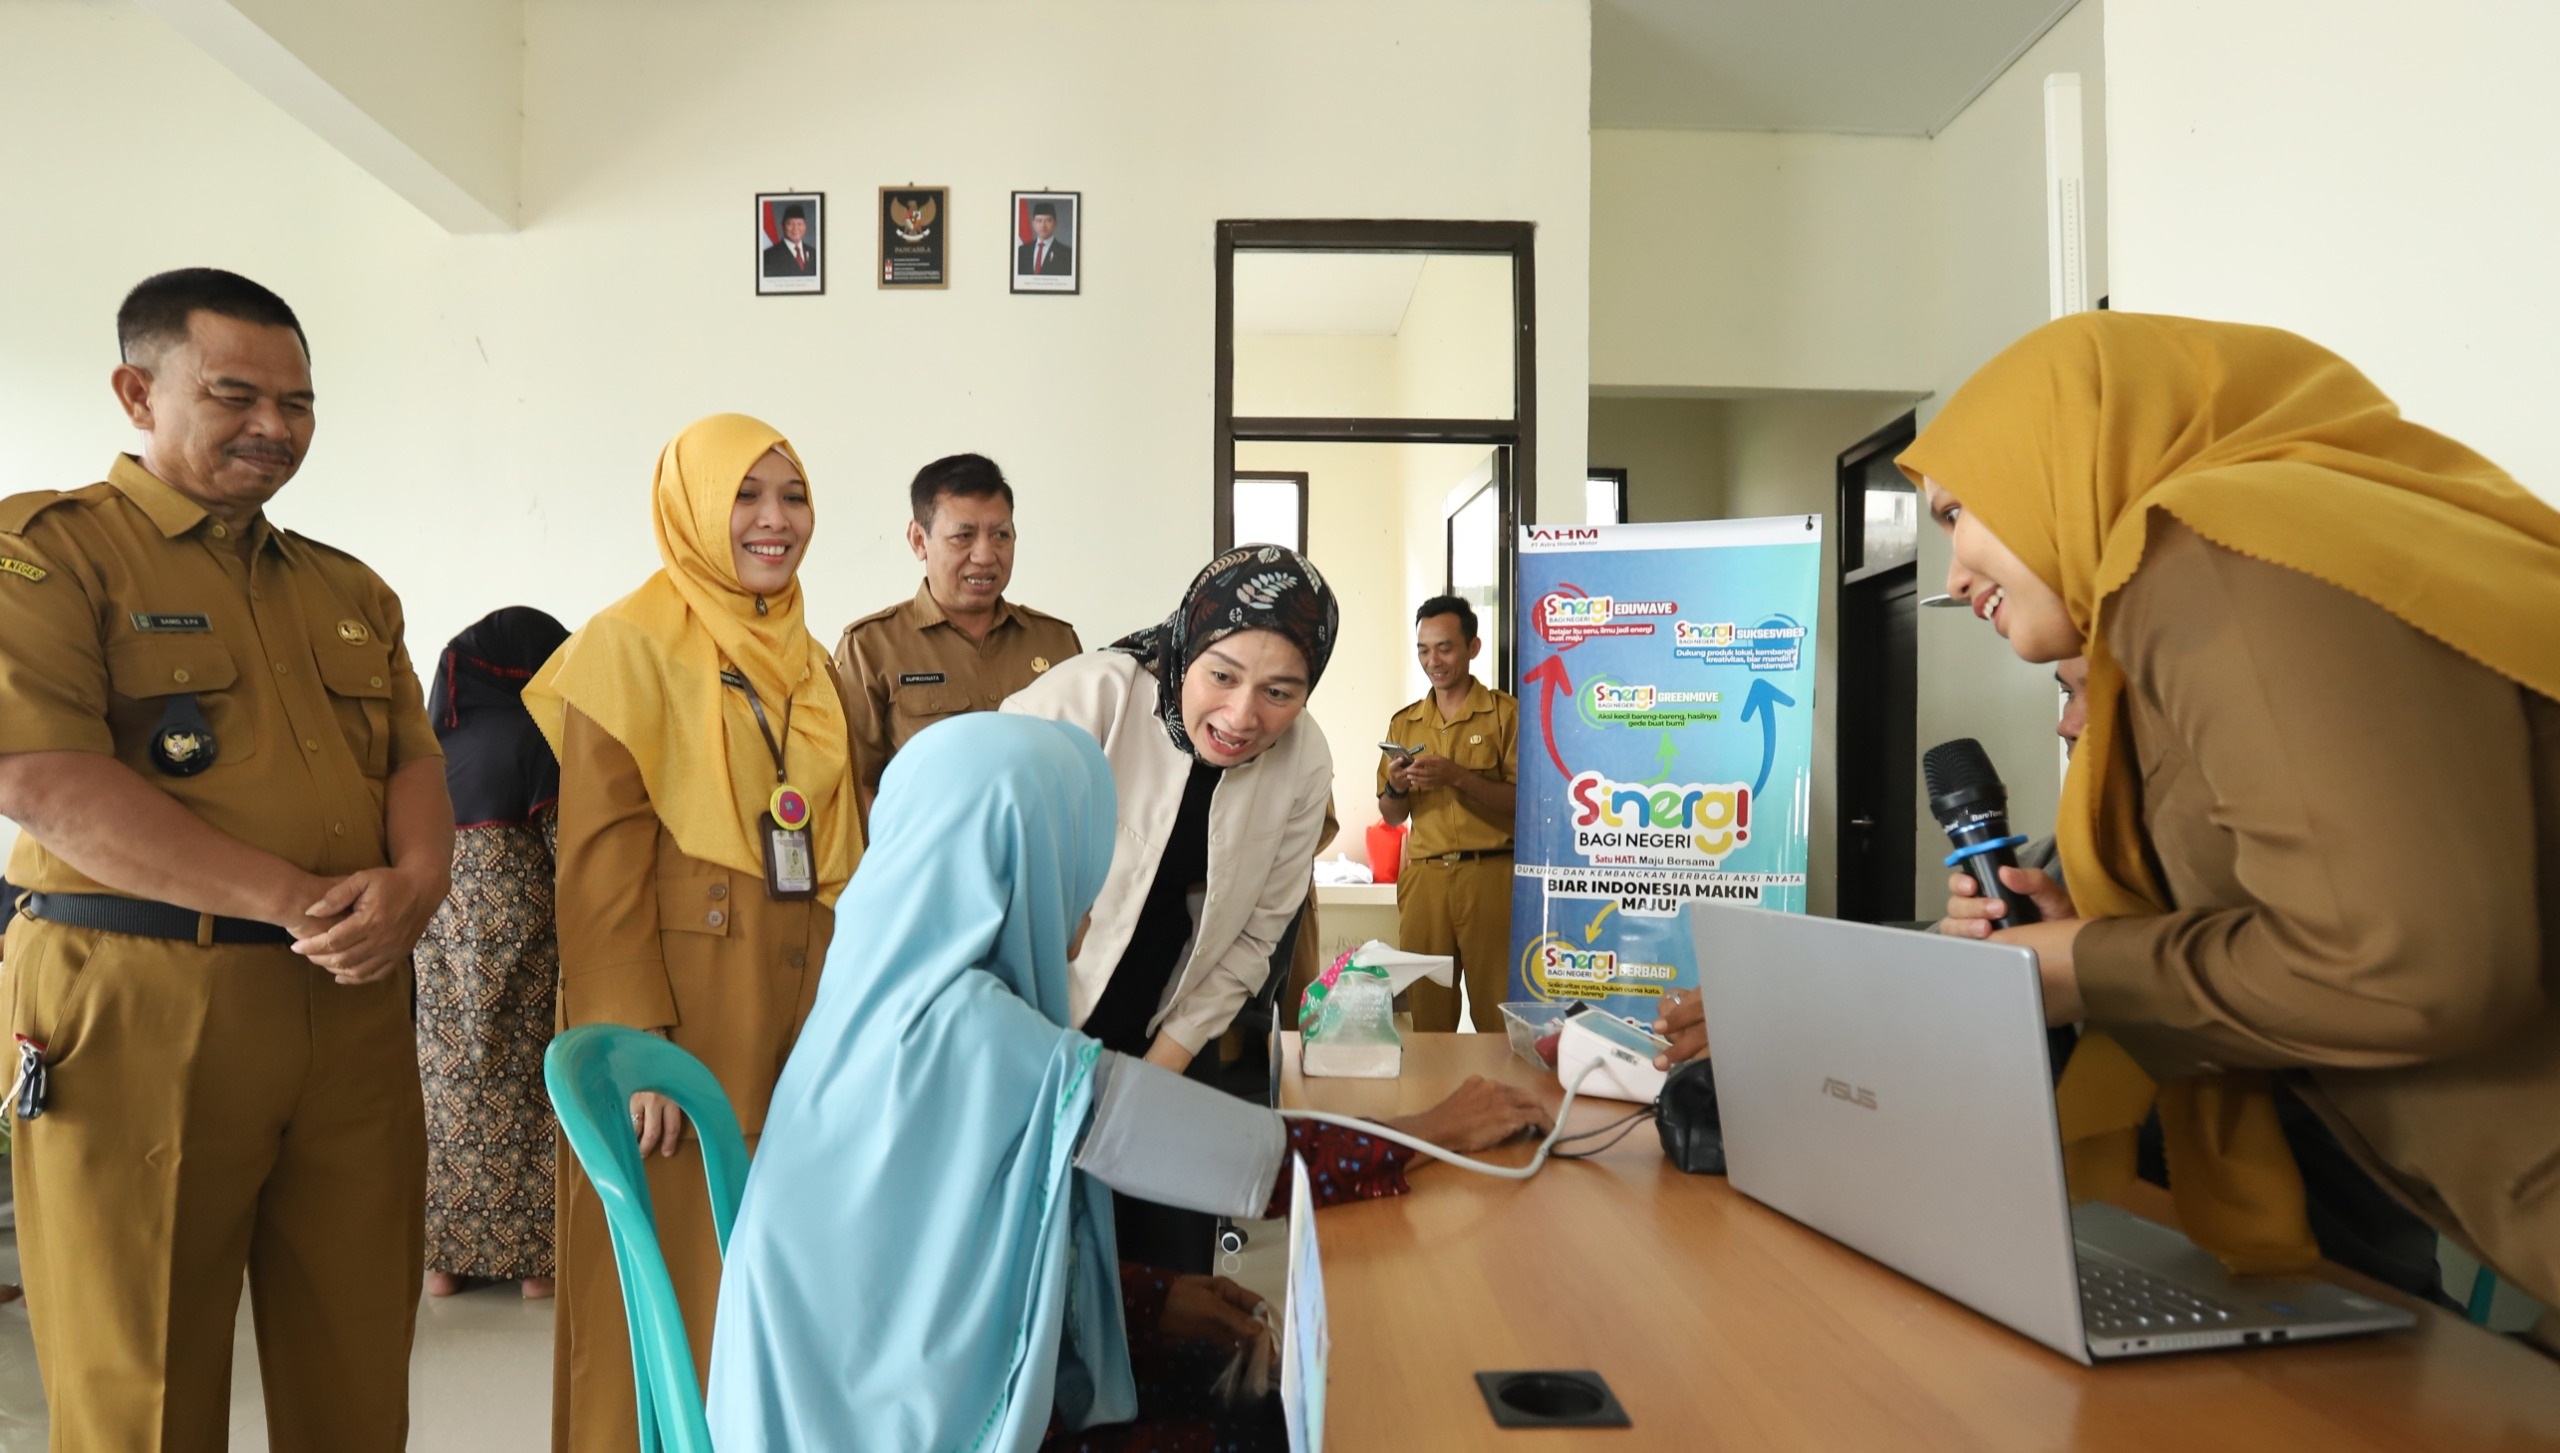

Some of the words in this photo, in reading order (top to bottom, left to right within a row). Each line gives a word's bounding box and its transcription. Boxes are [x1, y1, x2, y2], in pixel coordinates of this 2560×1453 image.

[1533, 529, 1598, 540] AHM
[1614, 602, 1672, 614] EDUWAVE
[1630, 626, 1652, 634] energi
[1736, 628, 1805, 640] SUKSESVIBES
[1676, 649, 1706, 658] Dukung
[1707, 648, 1734, 658] produk
[1657, 692, 1719, 702] GREENMOVE
[1579, 832, 1622, 846] BAGI
[1626, 834, 1691, 848] NEGERI
[1596, 854, 1613, 864] Satu
[1639, 856, 1664, 866] Maju
[1667, 857, 1715, 867] Bersama
[1590, 869, 1667, 879] KEMBANGKAN
[1672, 872, 1728, 881] BERBAGAI
[1734, 874, 1760, 882] AKSI
[1548, 879, 1588, 893] BIAR
[1591, 880, 1692, 896] INDONESIA
[1696, 884, 1758, 900] MAKIN
[1622, 897, 1676, 912] MAJU!
[1620, 964, 1670, 978] BERBAGI
[1580, 990, 1604, 998] bareng
[1822, 1076, 1878, 1111] ASUS
